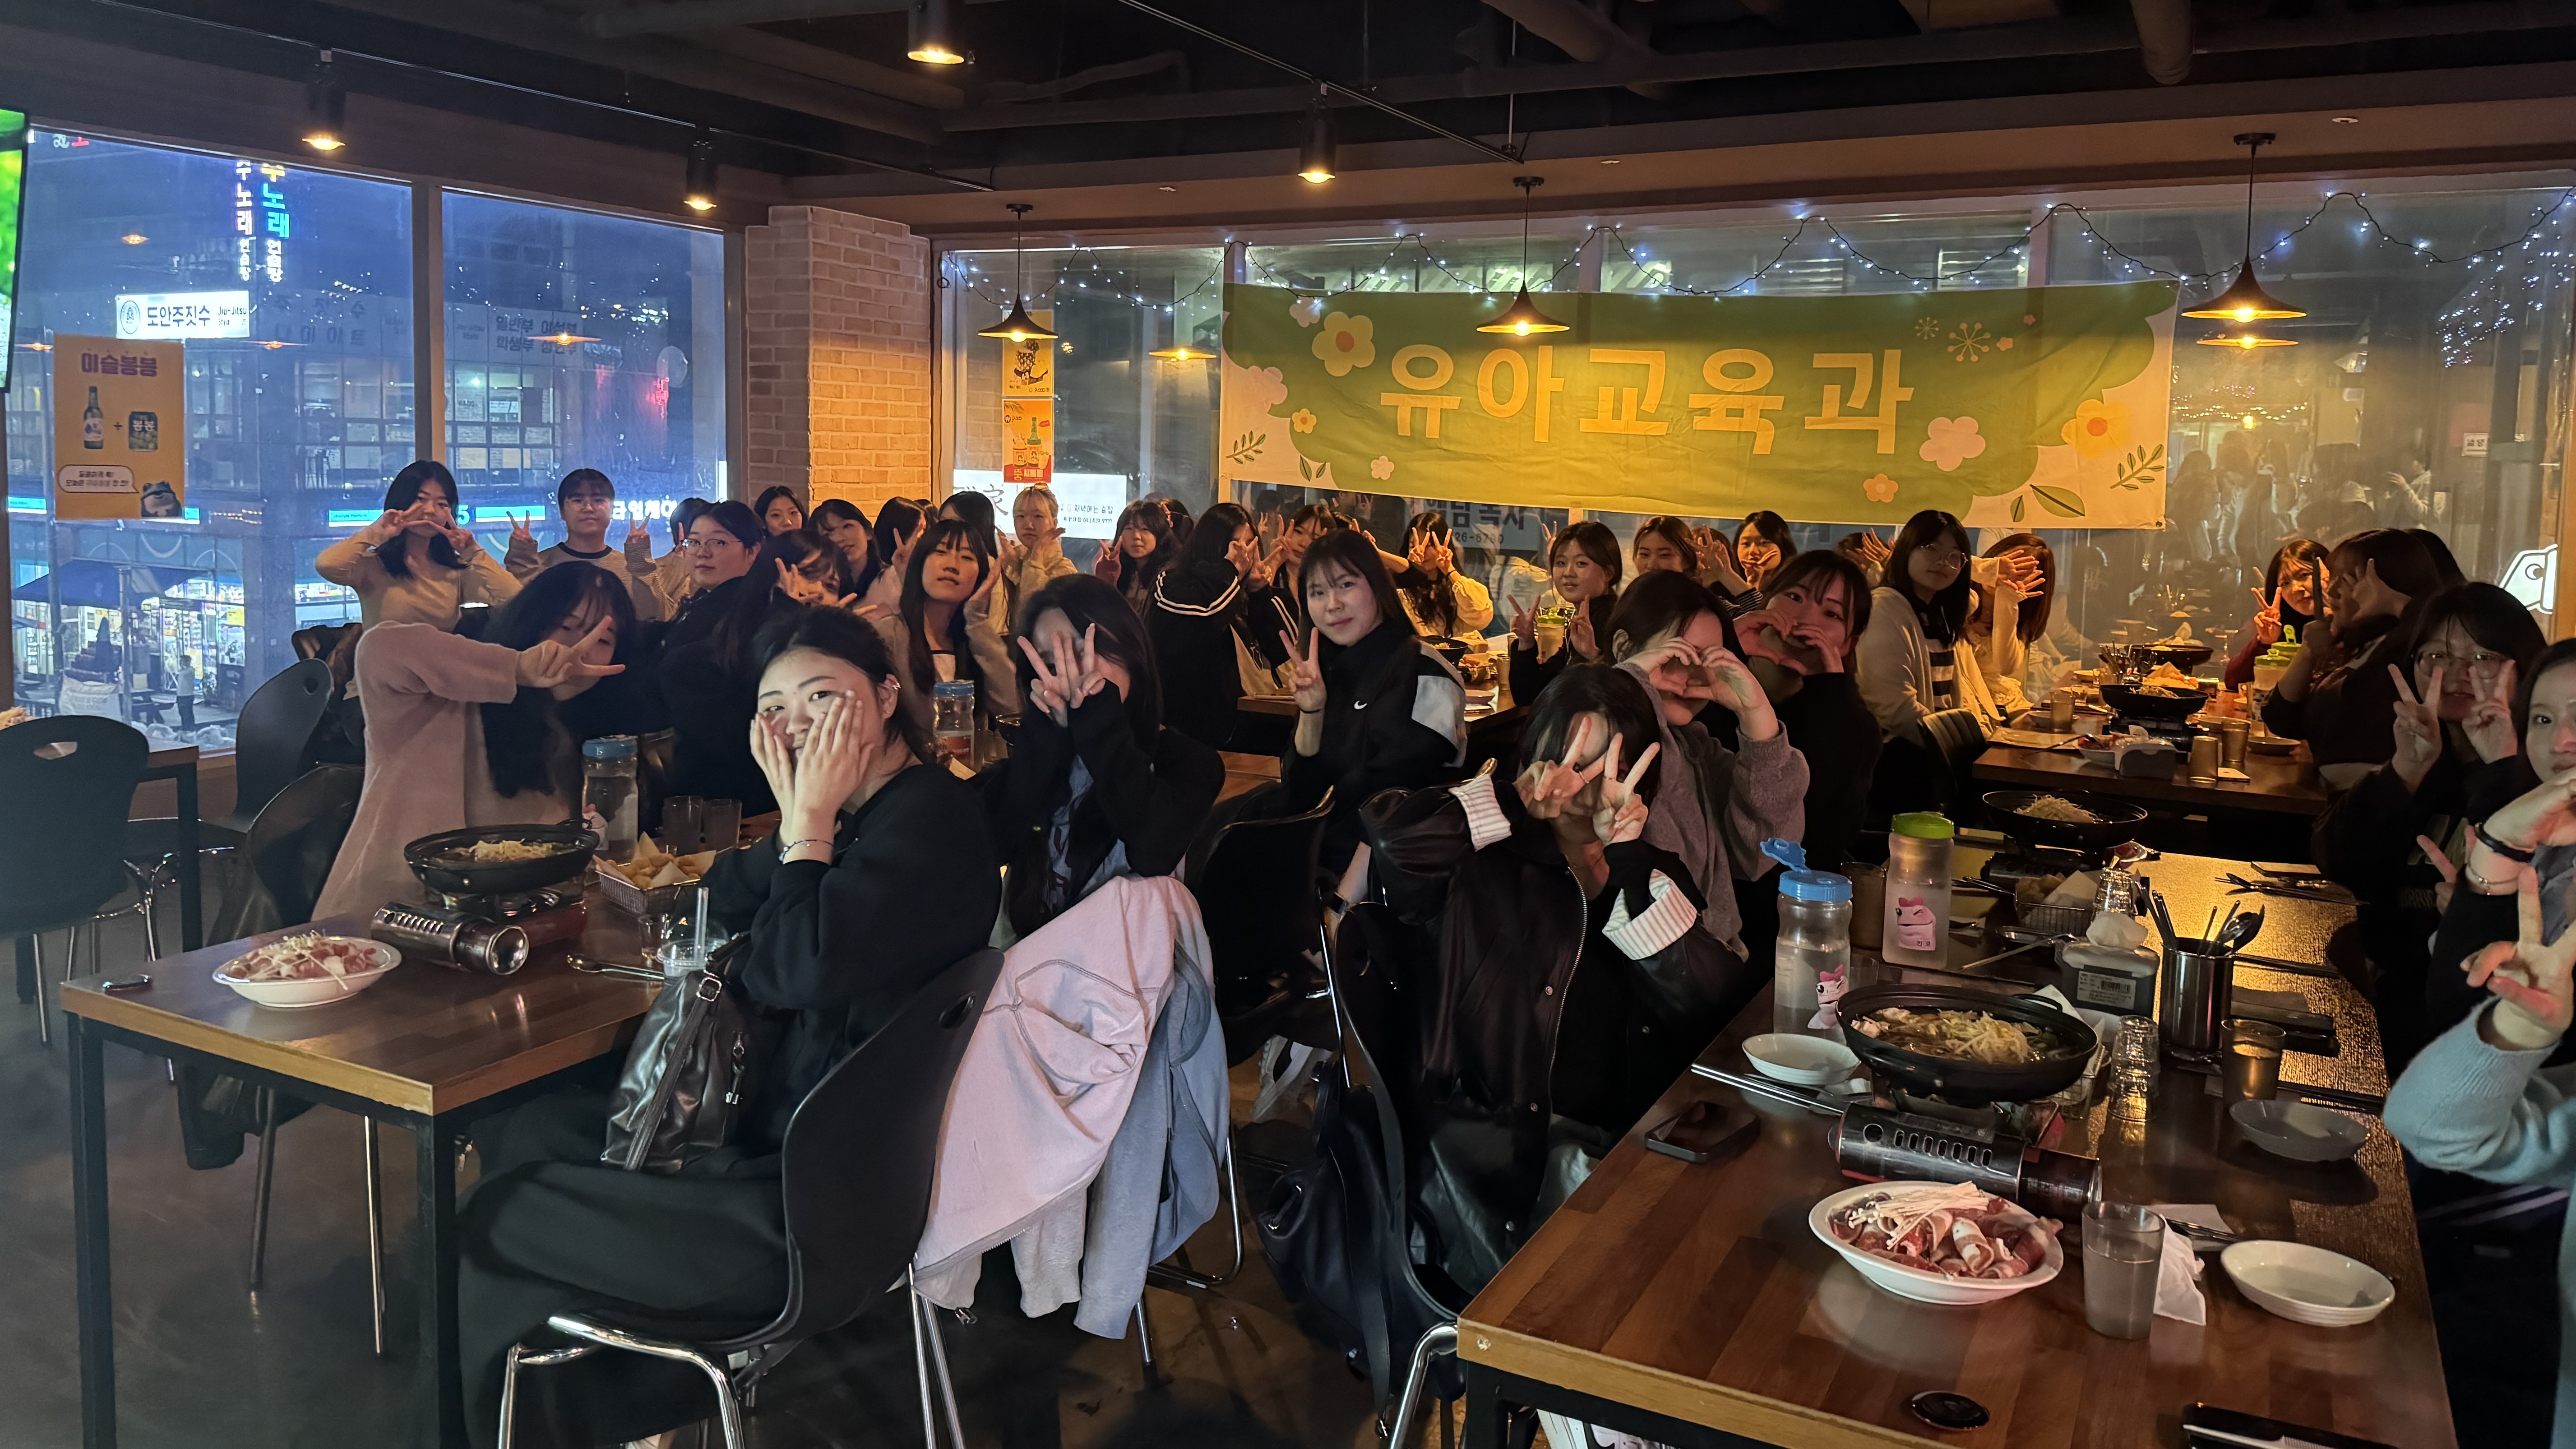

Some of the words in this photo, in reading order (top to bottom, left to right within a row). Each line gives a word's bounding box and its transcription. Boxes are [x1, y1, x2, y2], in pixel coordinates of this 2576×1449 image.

[148, 305, 211, 327] 도안주짓수
[218, 306, 247, 315] Jiu-Jitsu
[1381, 344, 1915, 454] 유아교육과
